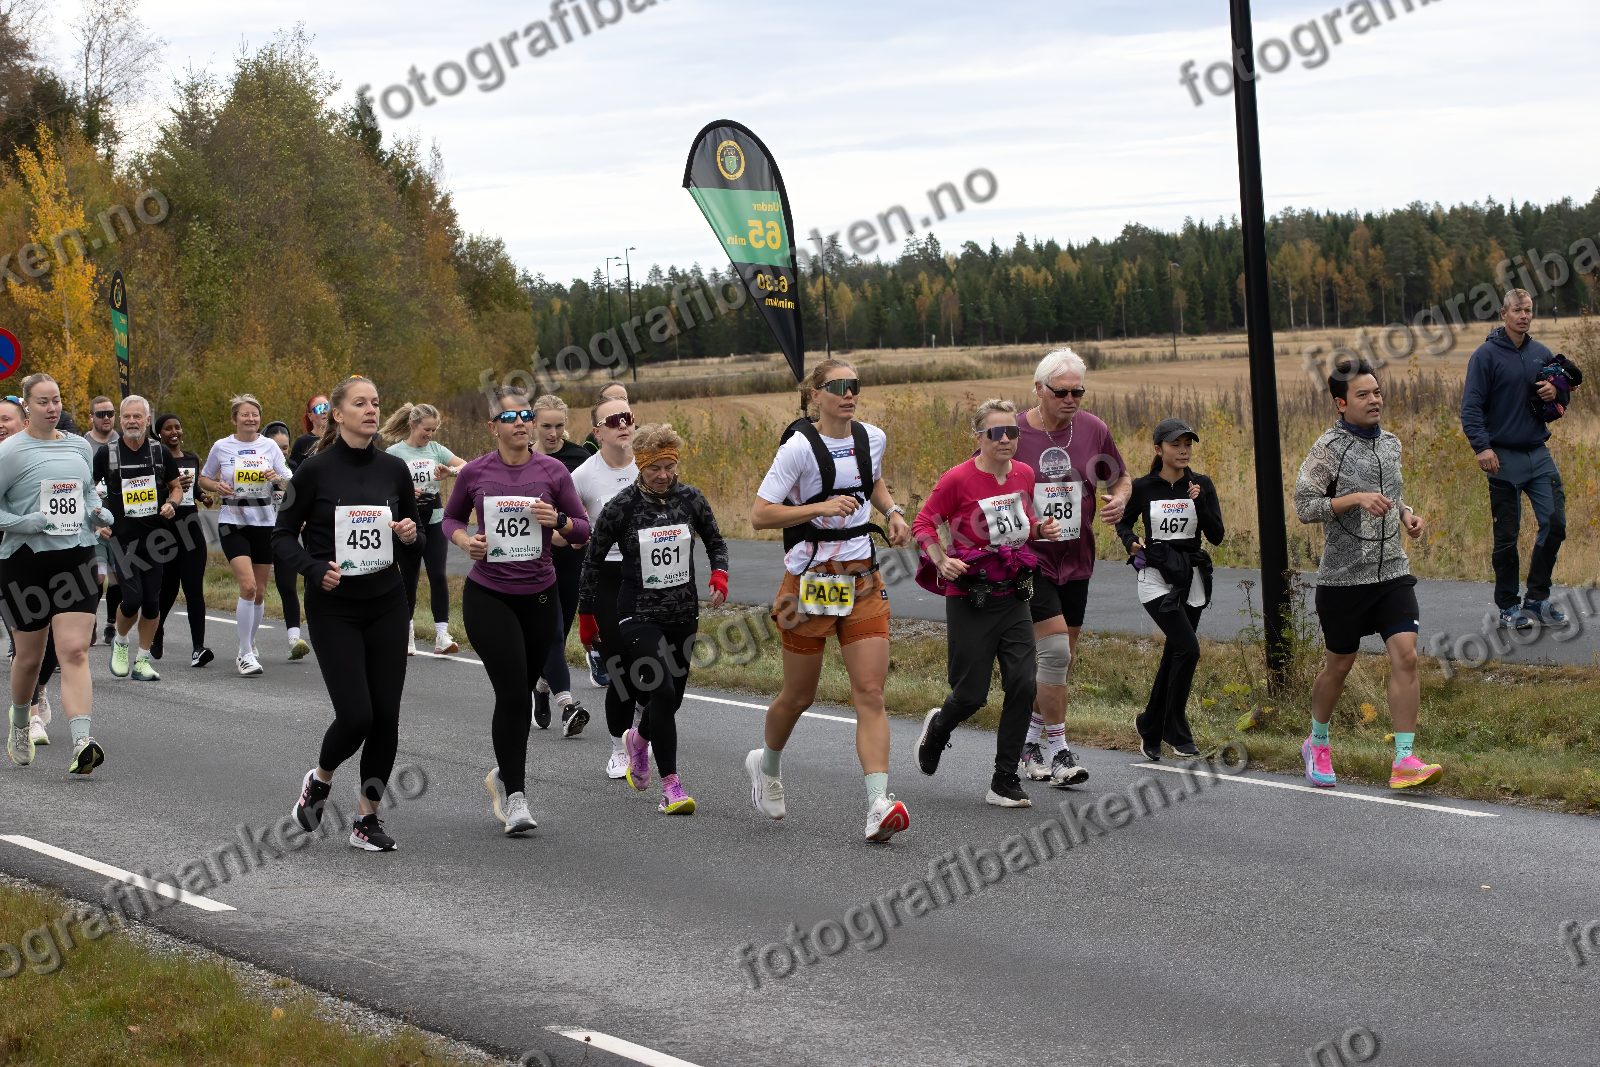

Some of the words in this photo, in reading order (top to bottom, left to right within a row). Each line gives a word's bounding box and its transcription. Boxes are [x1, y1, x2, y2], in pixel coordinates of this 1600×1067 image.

[412, 471, 430, 483] 461
[126, 490, 155, 503] PACE
[50, 498, 77, 515] 988
[1043, 502, 1073, 520] 458
[496, 517, 531, 537] 462
[652, 529, 682, 537] NORGES
[996, 514, 1023, 534] 614
[1160, 518, 1189, 533] 467
[347, 529, 382, 549] 453
[651, 546, 680, 566] 661
[805, 584, 850, 602] PACE
